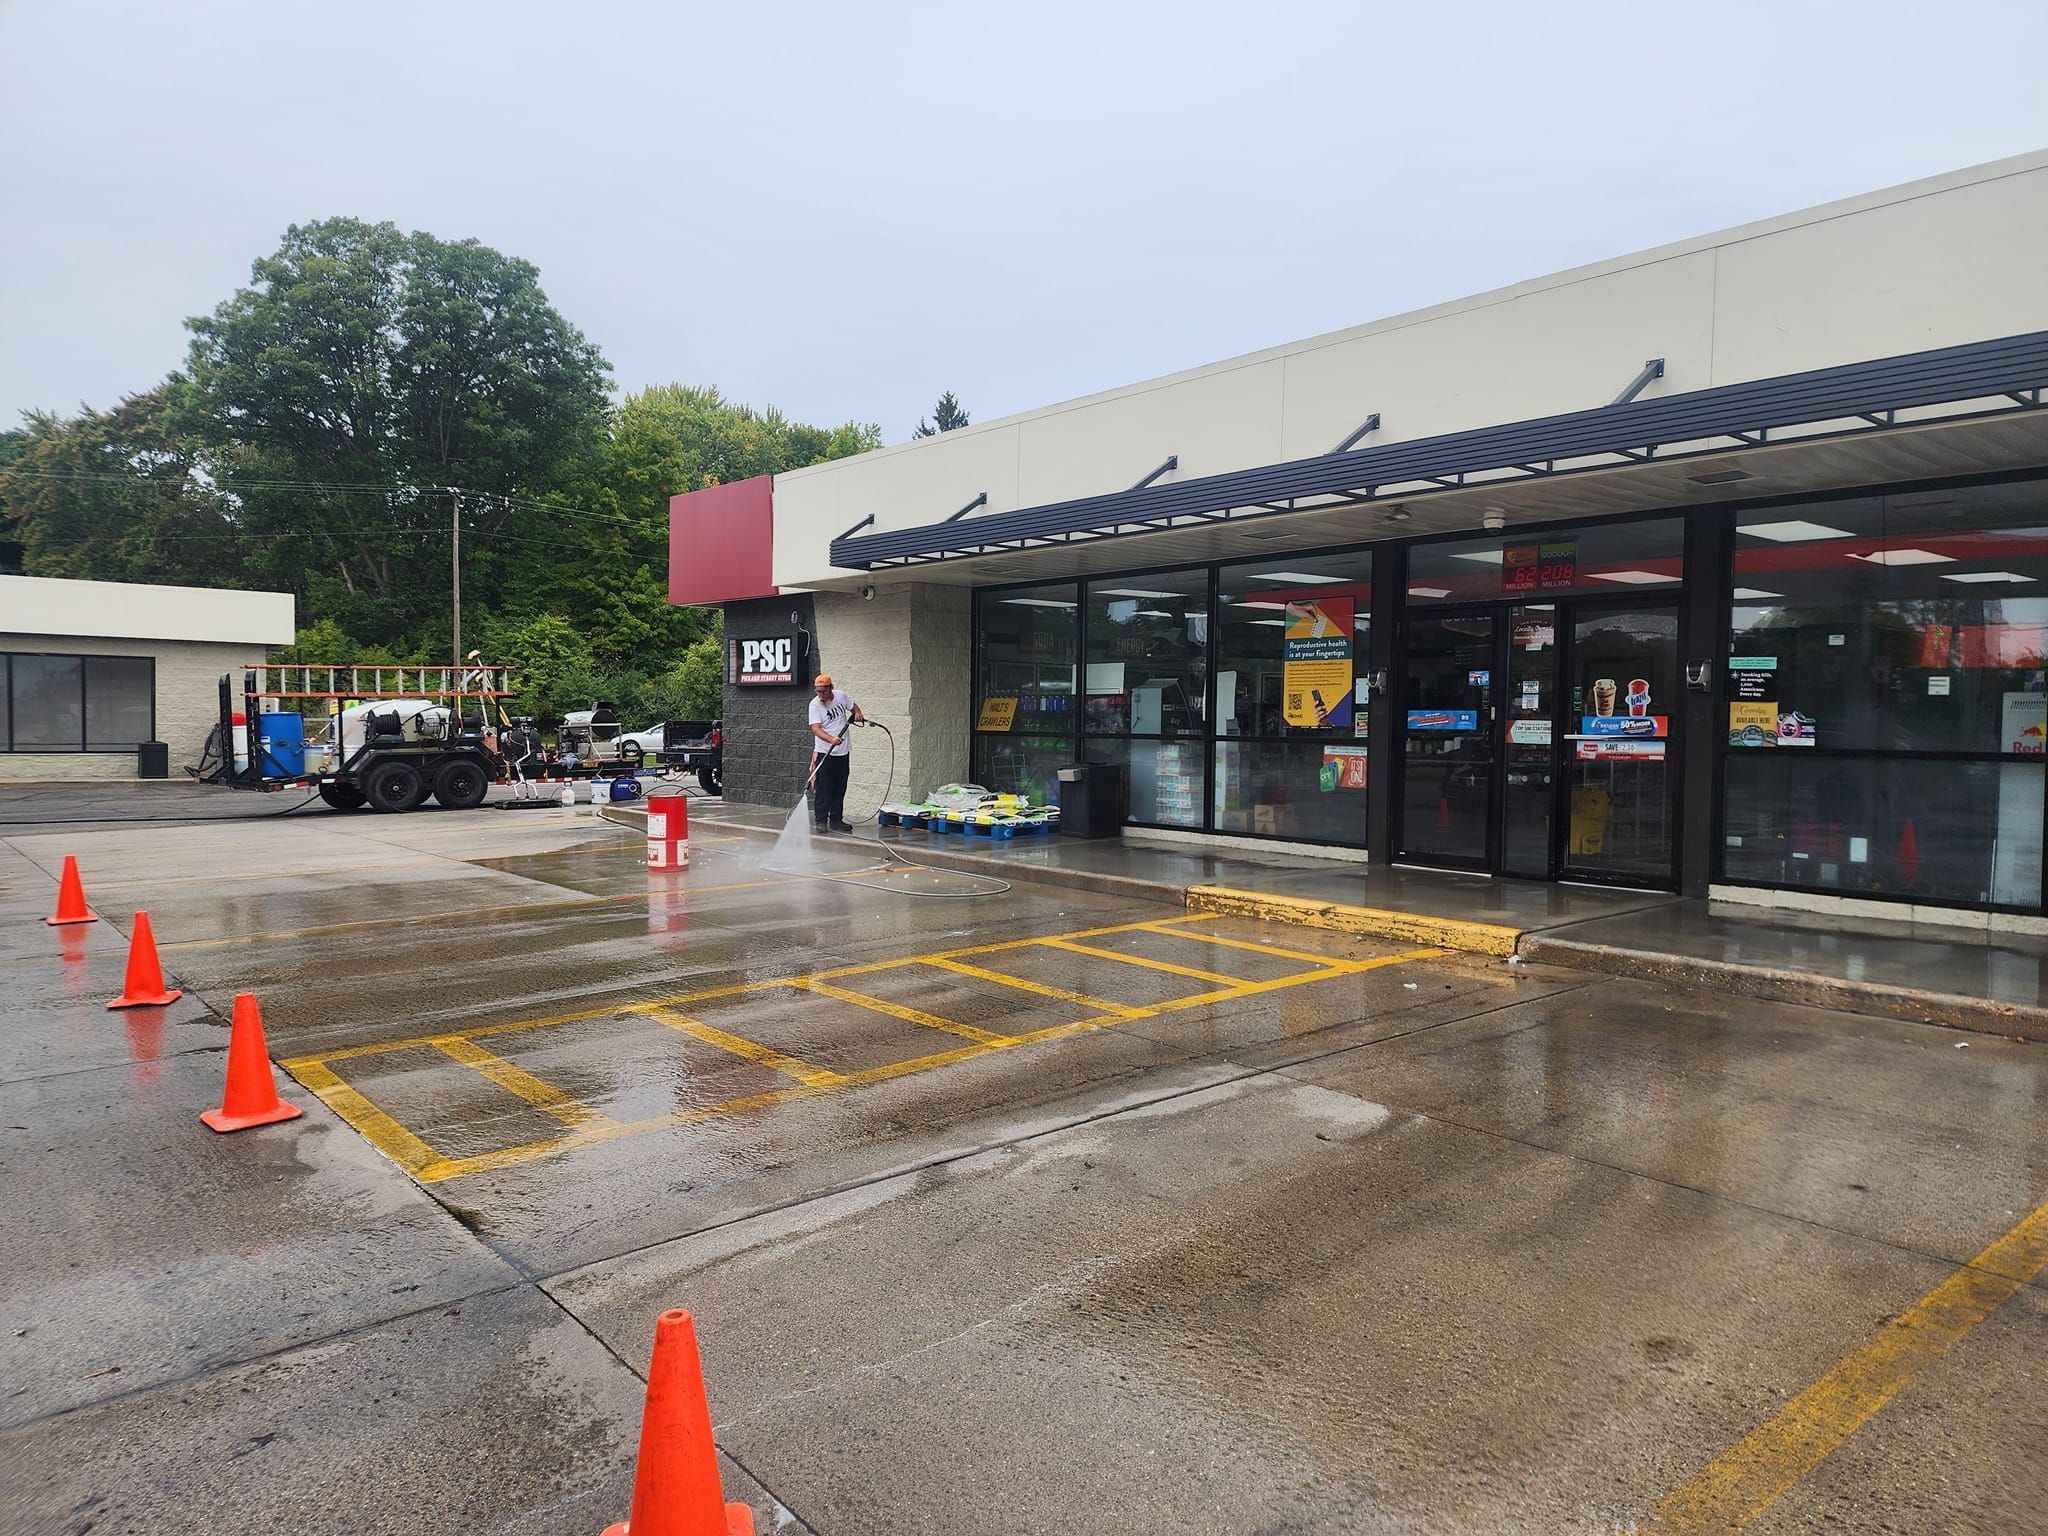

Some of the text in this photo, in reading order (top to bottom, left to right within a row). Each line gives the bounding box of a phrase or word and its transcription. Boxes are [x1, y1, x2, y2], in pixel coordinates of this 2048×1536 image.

[1516, 564, 1574, 582] 62 208
[1505, 580, 1571, 590] MILLION MILLION
[1033, 631, 1055, 648] SODA
[1117, 637, 1146, 654] ENERGY
[1289, 641, 1327, 651] Reproductive
[742, 638, 791, 673] PSC
[1302, 652, 1315, 660] your
[1316, 650, 1345, 659] fingertips
[989, 702, 1009, 713] WALT'S
[979, 716, 1012, 727] CRAWLERS
[1604, 743, 1618, 751] SAVE
[2013, 741, 2043, 753] Red
[1351, 760, 1360, 771] IT'S
